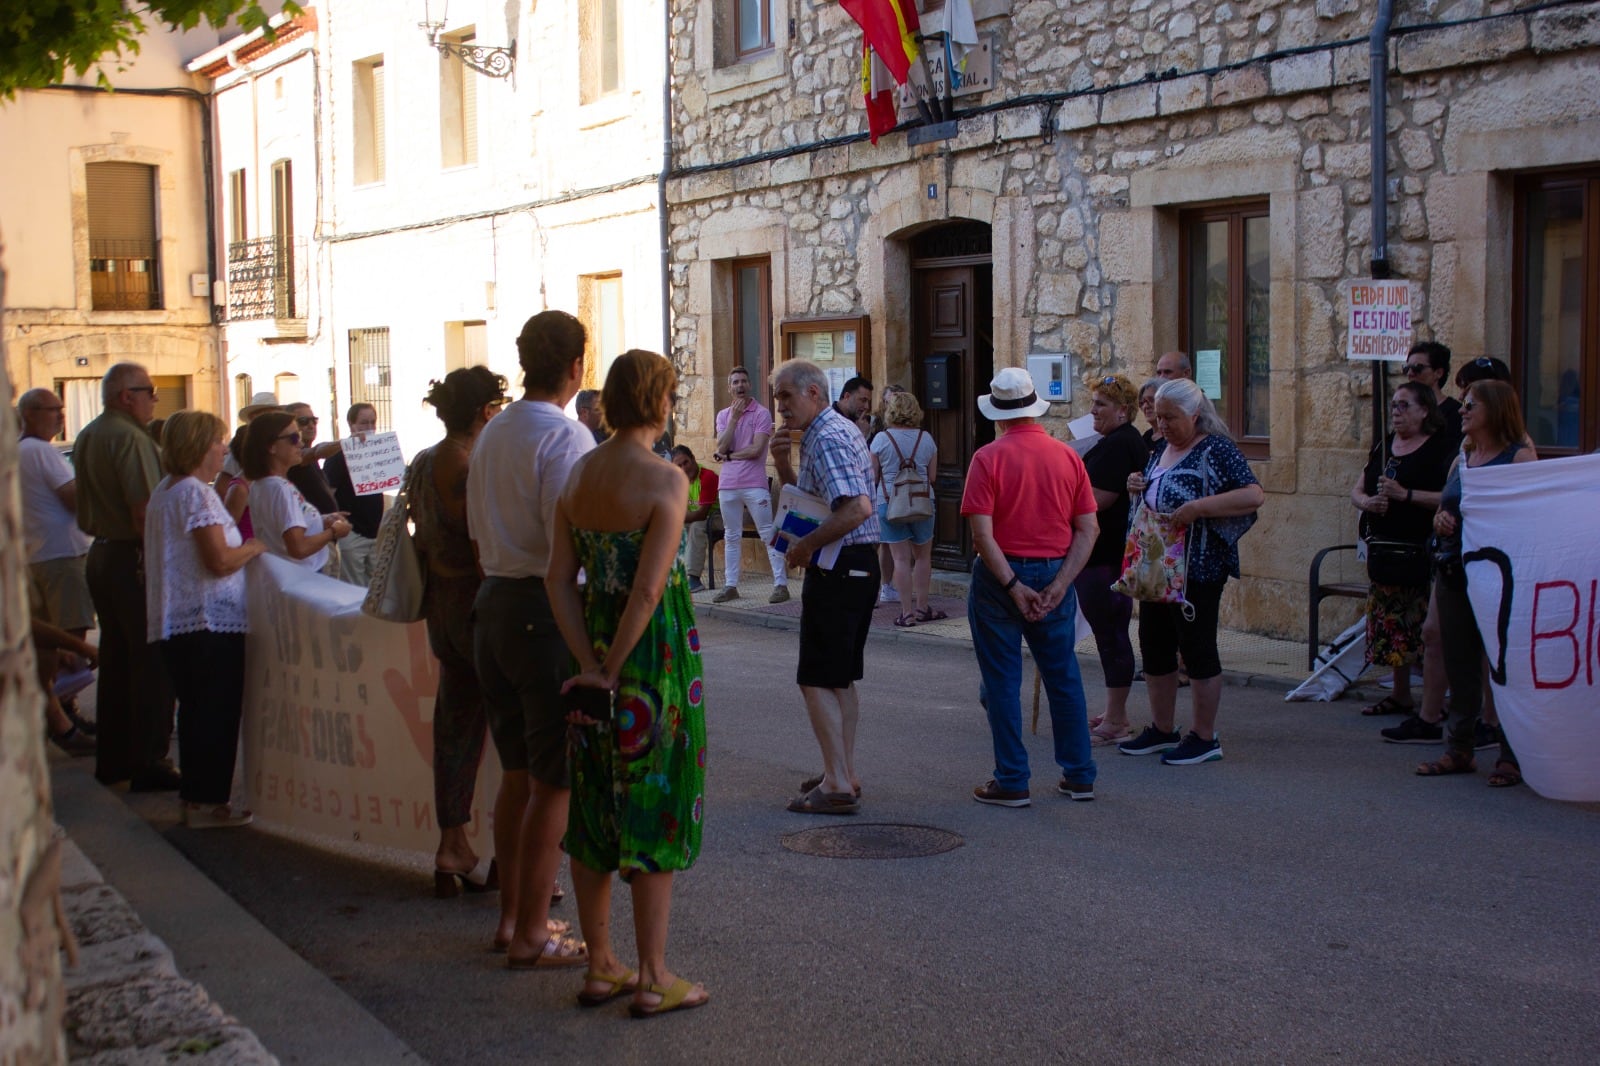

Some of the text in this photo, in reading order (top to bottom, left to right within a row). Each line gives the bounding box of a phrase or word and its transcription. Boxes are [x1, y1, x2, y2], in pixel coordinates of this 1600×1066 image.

[929, 186, 934, 197] 1
[1351, 286, 1409, 306] CADA UNO
[1353, 309, 1411, 330] GESTIONE
[1530, 579, 1600, 690] BI
